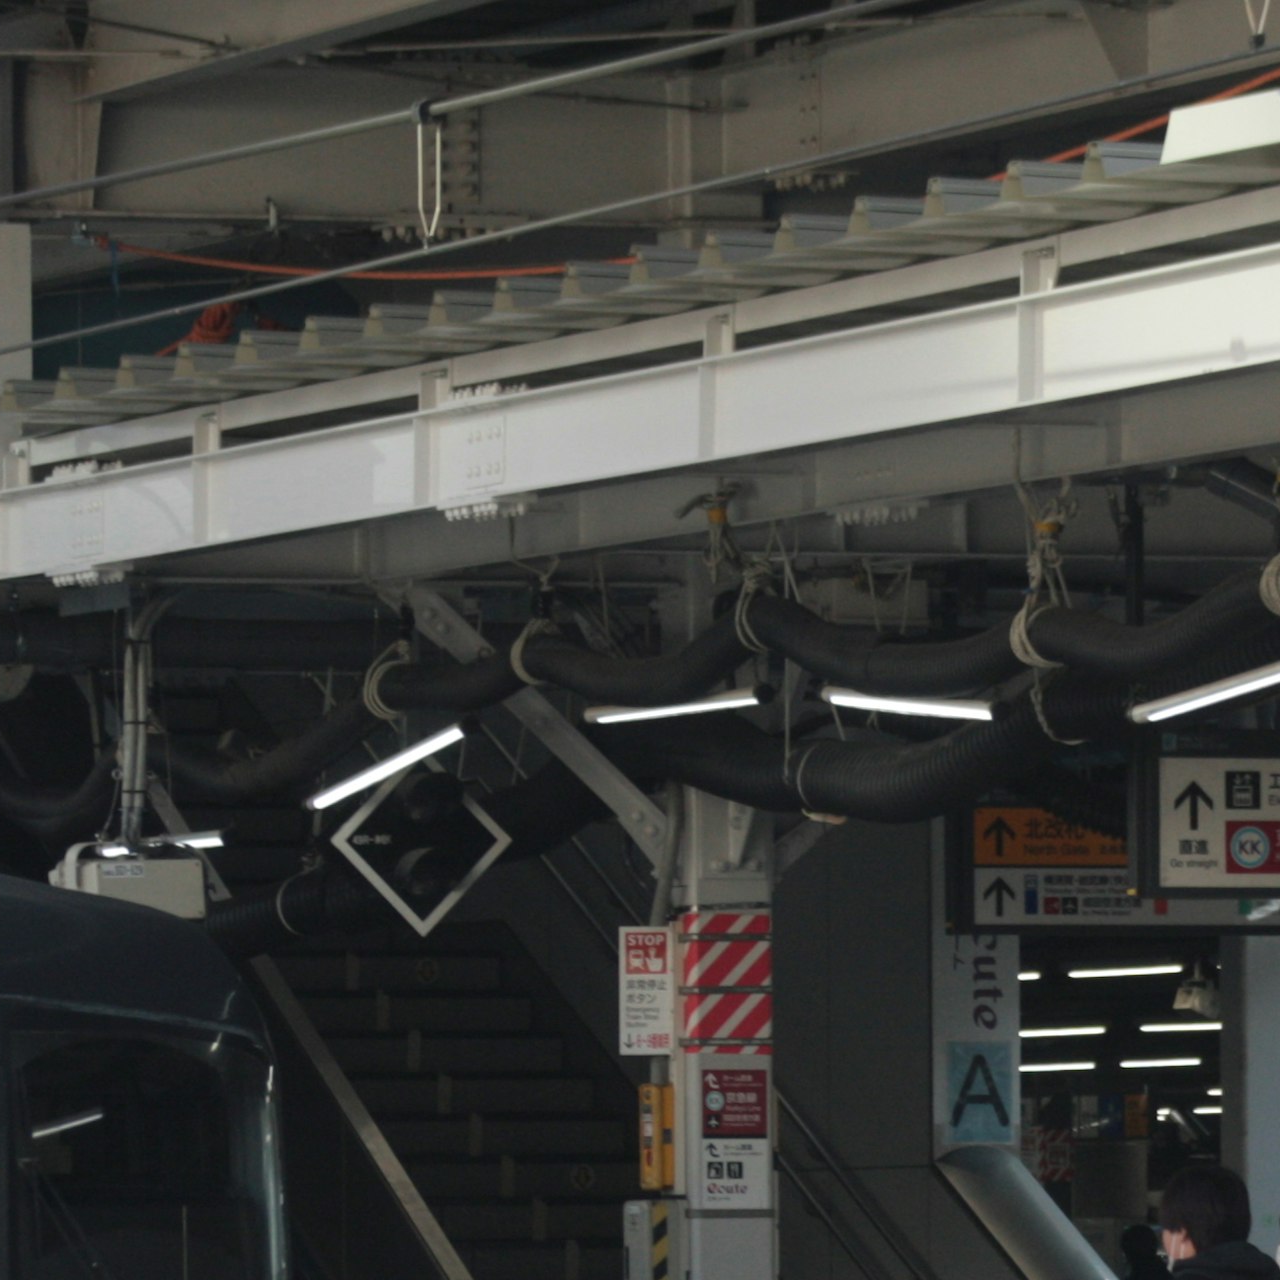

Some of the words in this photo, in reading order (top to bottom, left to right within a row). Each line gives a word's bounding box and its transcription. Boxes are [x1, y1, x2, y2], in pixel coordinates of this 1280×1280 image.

[1178, 839, 1209, 855] 直進
[1237, 838, 1262, 856] KK
[1170, 858, 1184, 869] Go
[627, 934, 665, 947] STOP
[949, 1053, 1010, 1128] A
